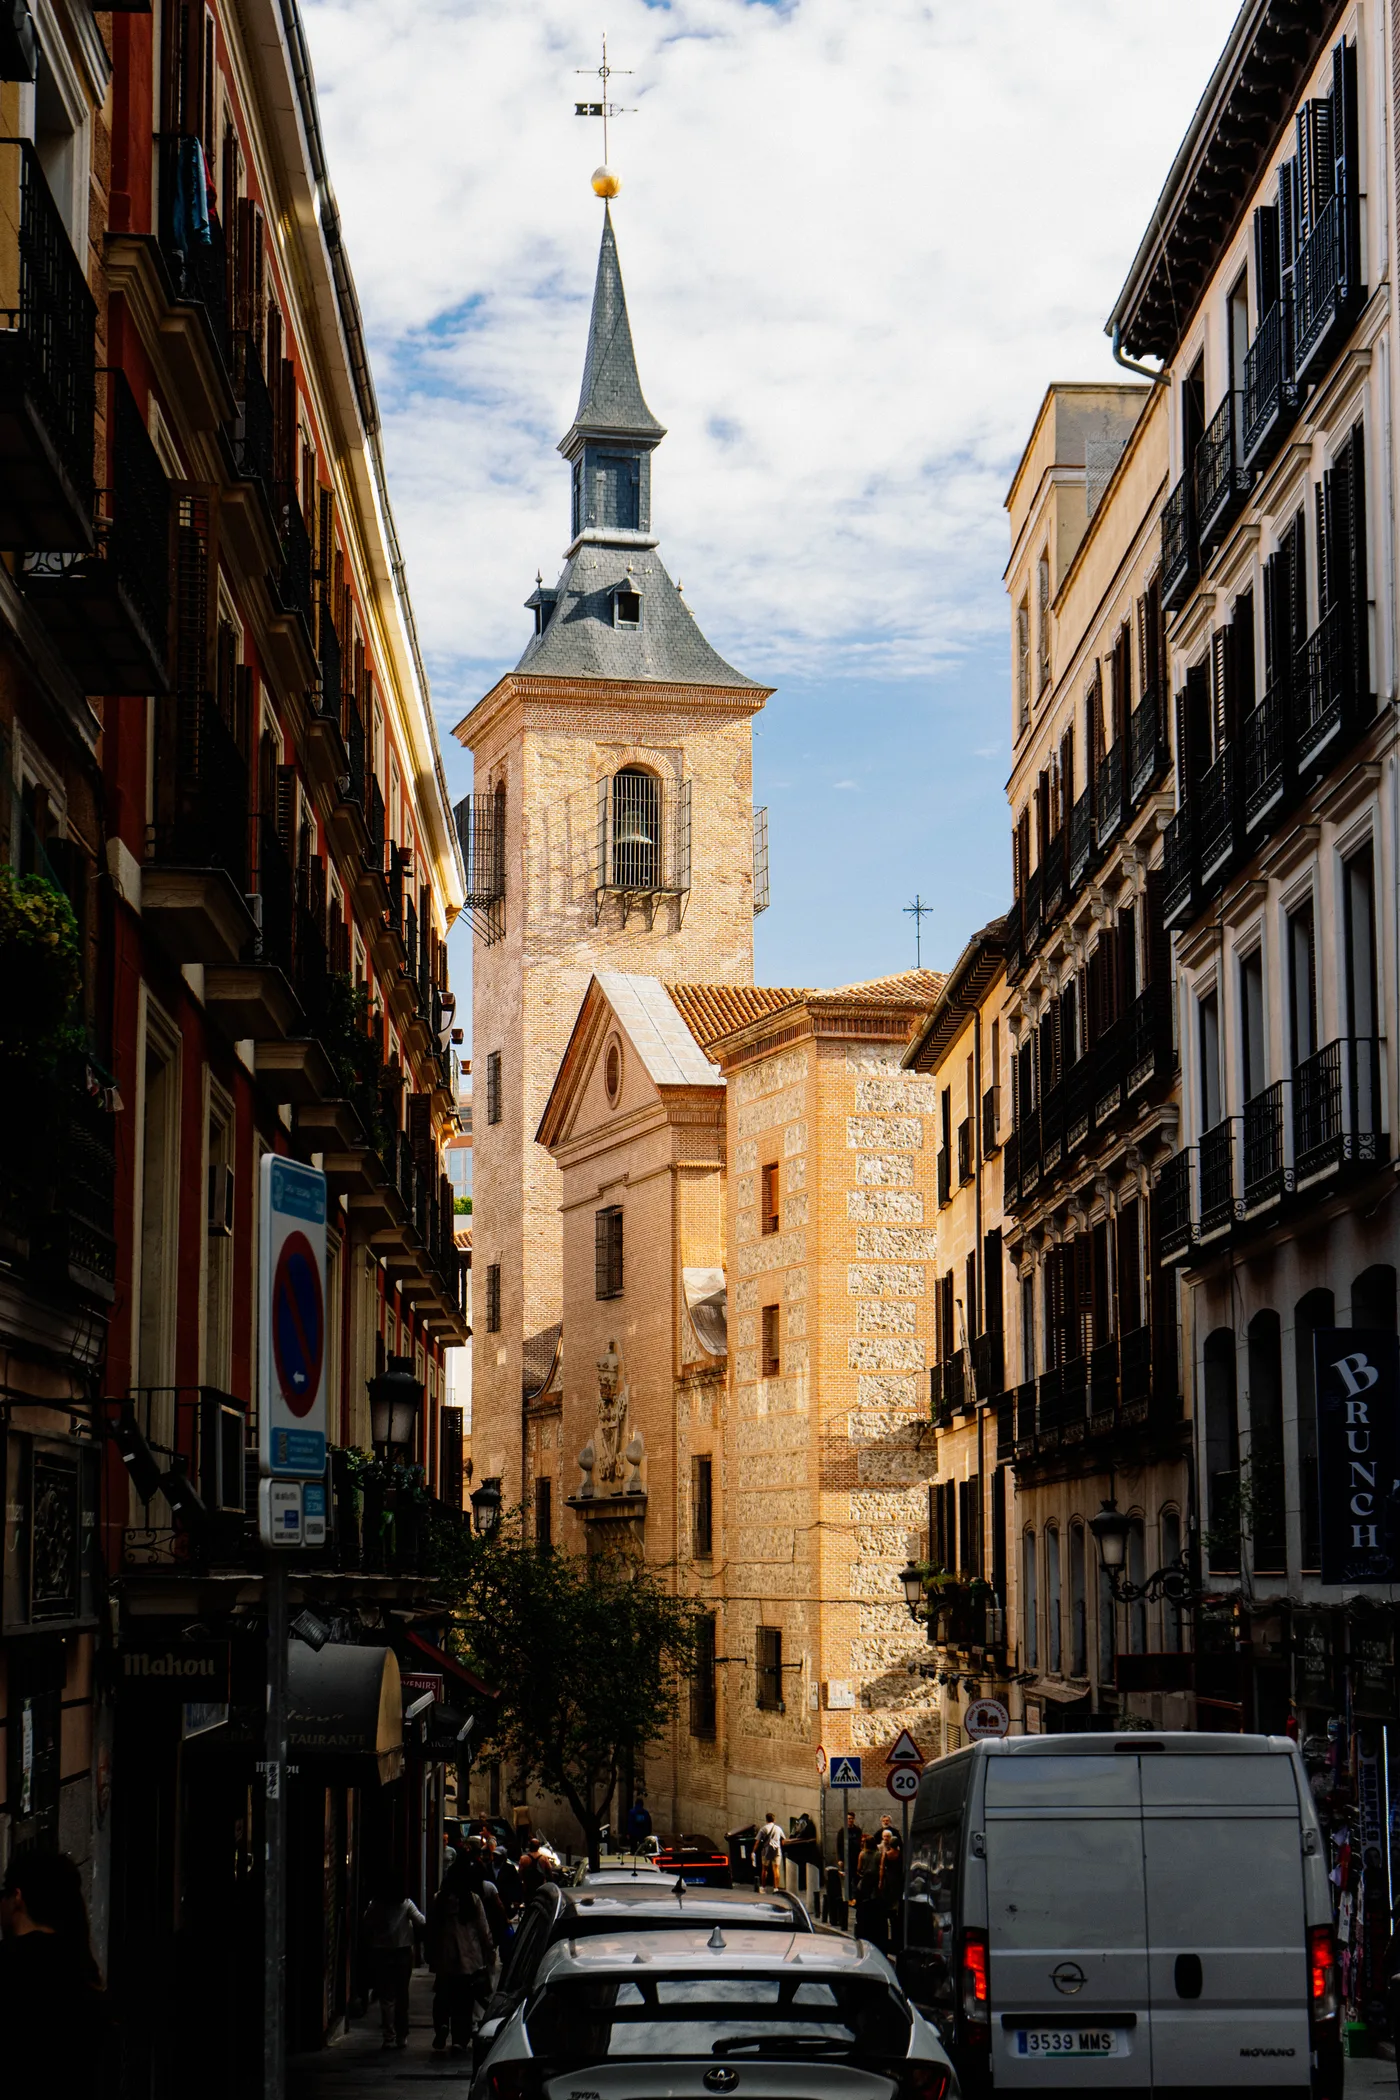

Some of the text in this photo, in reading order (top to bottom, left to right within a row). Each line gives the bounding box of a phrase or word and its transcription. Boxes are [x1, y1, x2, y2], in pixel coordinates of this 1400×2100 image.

[1330, 1352, 1380, 1548] BRUNCH
[122, 1652, 216, 1676] Mahou
[895, 1776, 916, 1789] 20
[601, 1830, 608, 1838] P
[1030, 2034, 1111, 2050] 3539 MMS
[1240, 2048, 1295, 2057] MOVANO
[570, 2091, 599, 2099] TOYOTA
